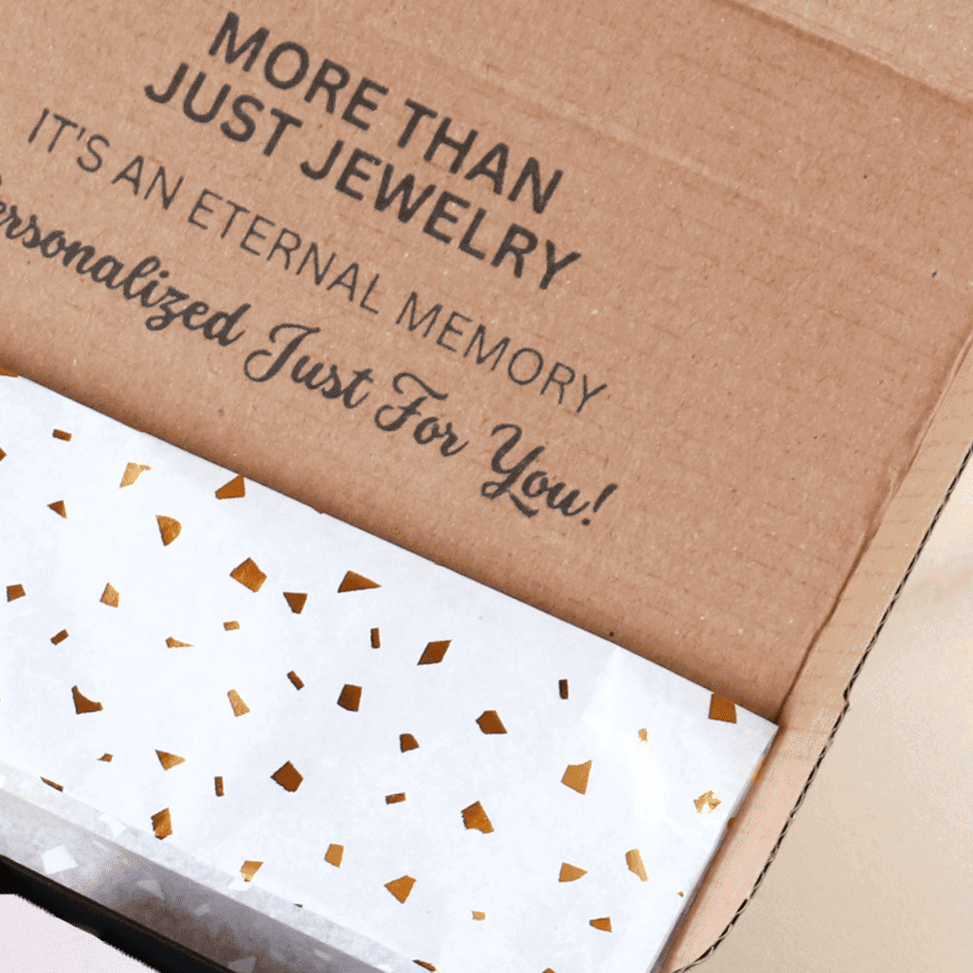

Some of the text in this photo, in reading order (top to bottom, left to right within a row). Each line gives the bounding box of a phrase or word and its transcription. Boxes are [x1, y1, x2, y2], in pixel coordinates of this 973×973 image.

[144, 62, 582, 291] JUST JEWELRY
[208, 12, 564, 214] MORE THAN
[27, 107, 608, 415] IT'S AN ETERNAL MEMORY
[244, 323, 378, 409] Just
[374, 373, 469, 457] For
[480, 424, 618, 526] You!
